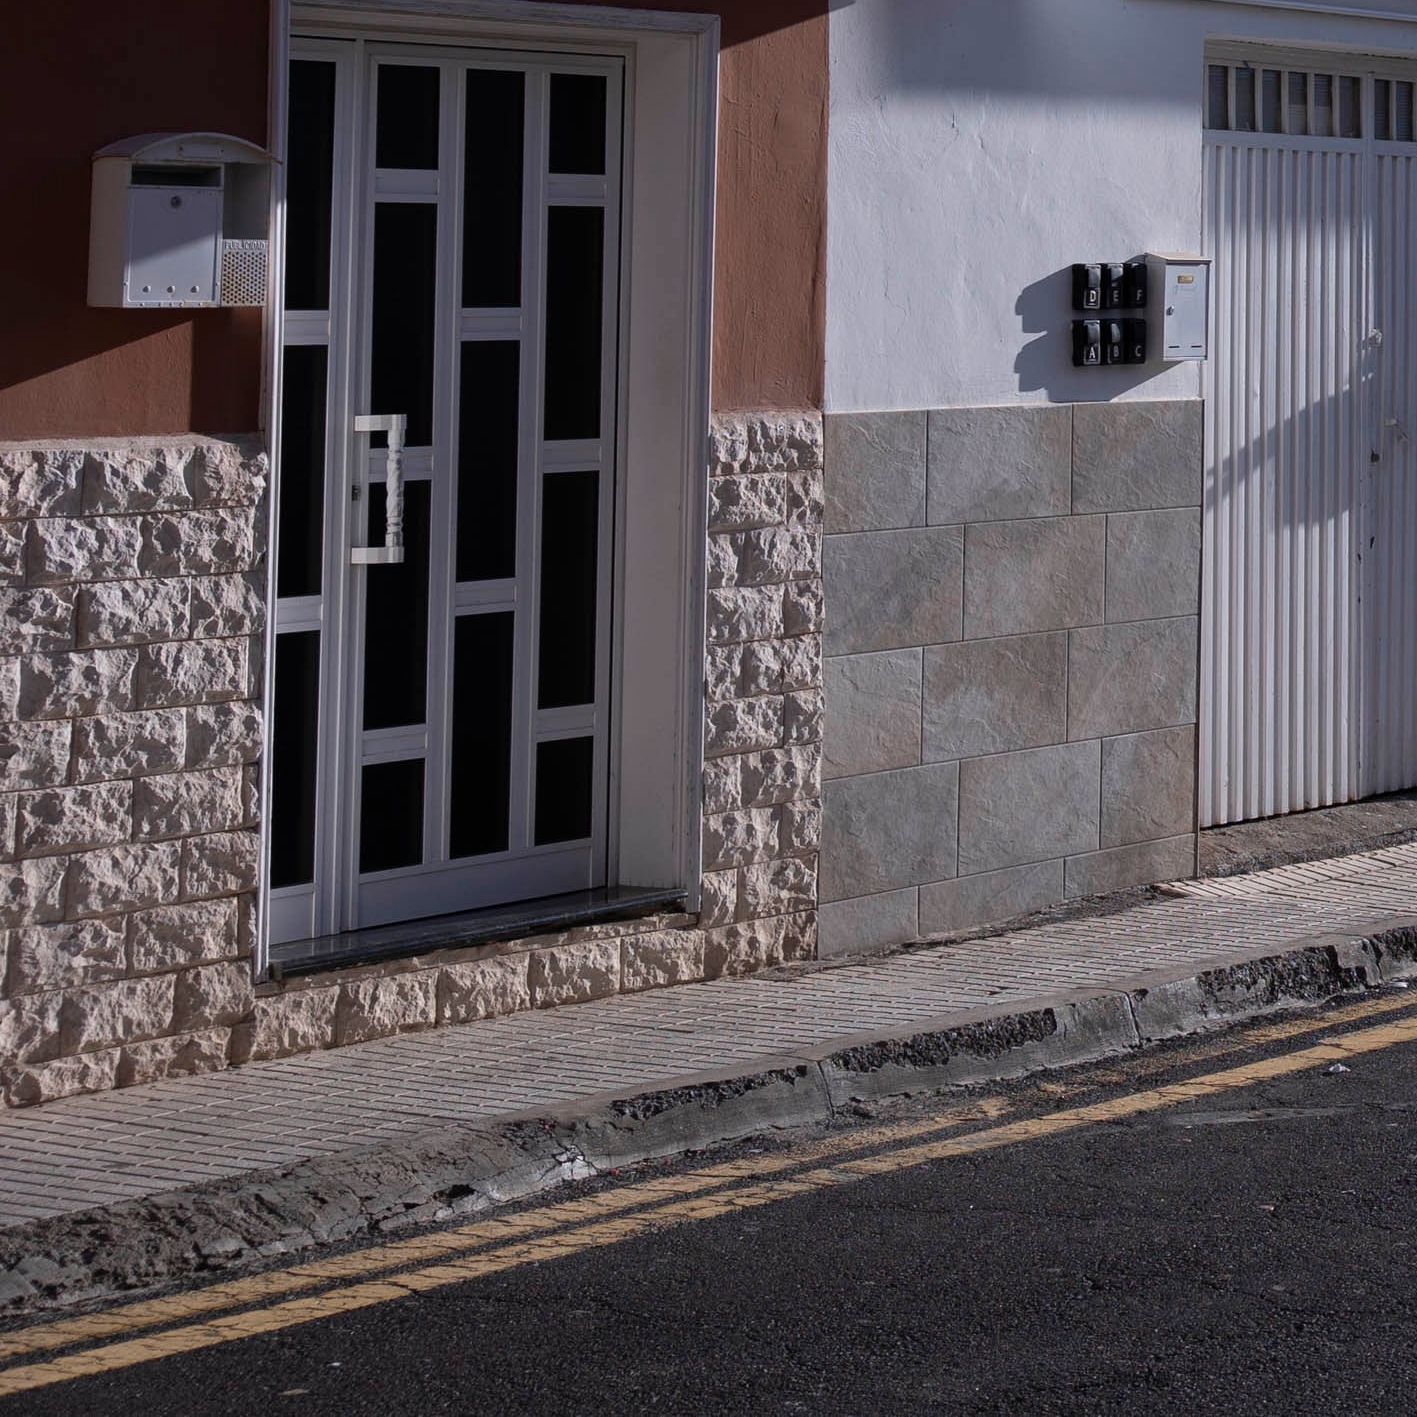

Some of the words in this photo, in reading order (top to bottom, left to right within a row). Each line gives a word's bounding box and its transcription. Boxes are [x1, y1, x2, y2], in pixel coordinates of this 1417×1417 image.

[1089, 290, 1097, 302] D
[1113, 290, 1119, 302] E
[1136, 289, 1142, 301] F
[1089, 346, 1096, 359] A
[1113, 345, 1120, 357] B
[1135, 345, 1142, 357] C
